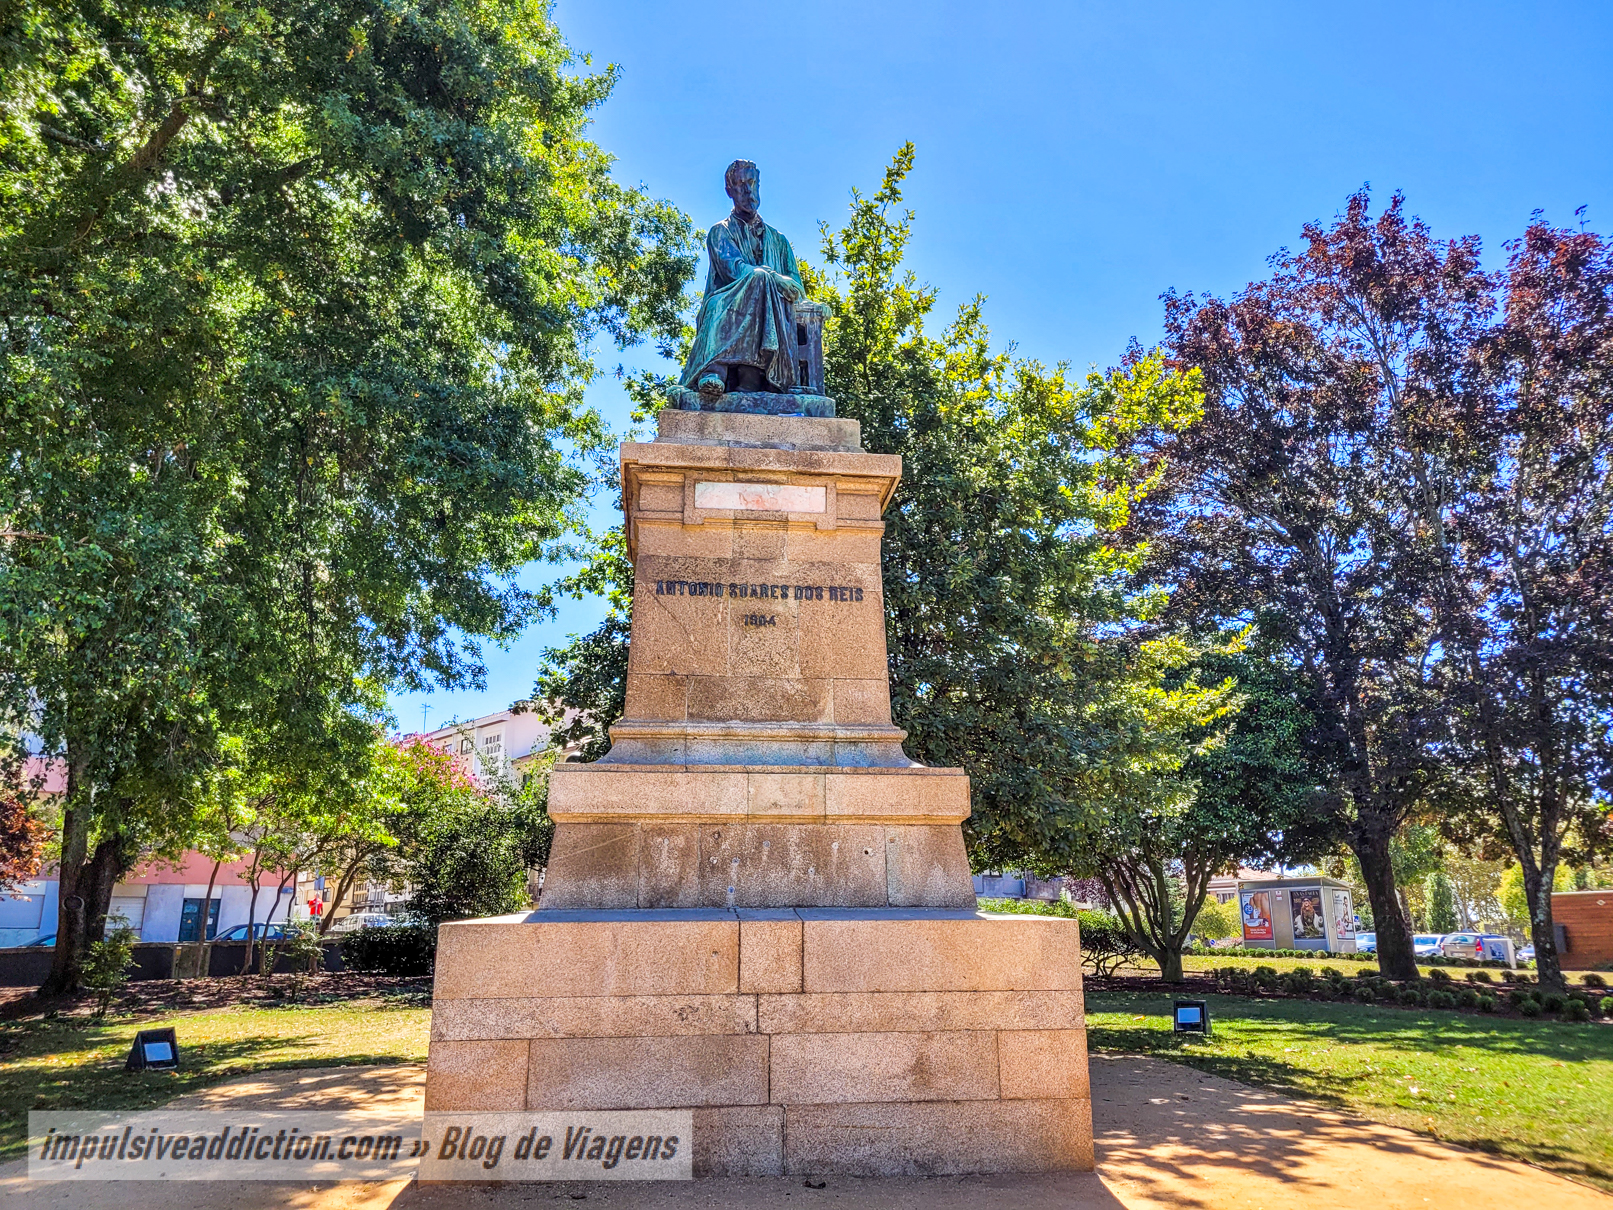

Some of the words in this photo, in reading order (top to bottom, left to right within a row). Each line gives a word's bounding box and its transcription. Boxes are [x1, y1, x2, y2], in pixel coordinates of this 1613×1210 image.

[656, 580, 724, 598] ANTONIO
[729, 583, 789, 600] SOARES
[795, 585, 824, 601] DOS
[829, 585, 864, 602] REIS
[744, 614, 777, 627] 1904
